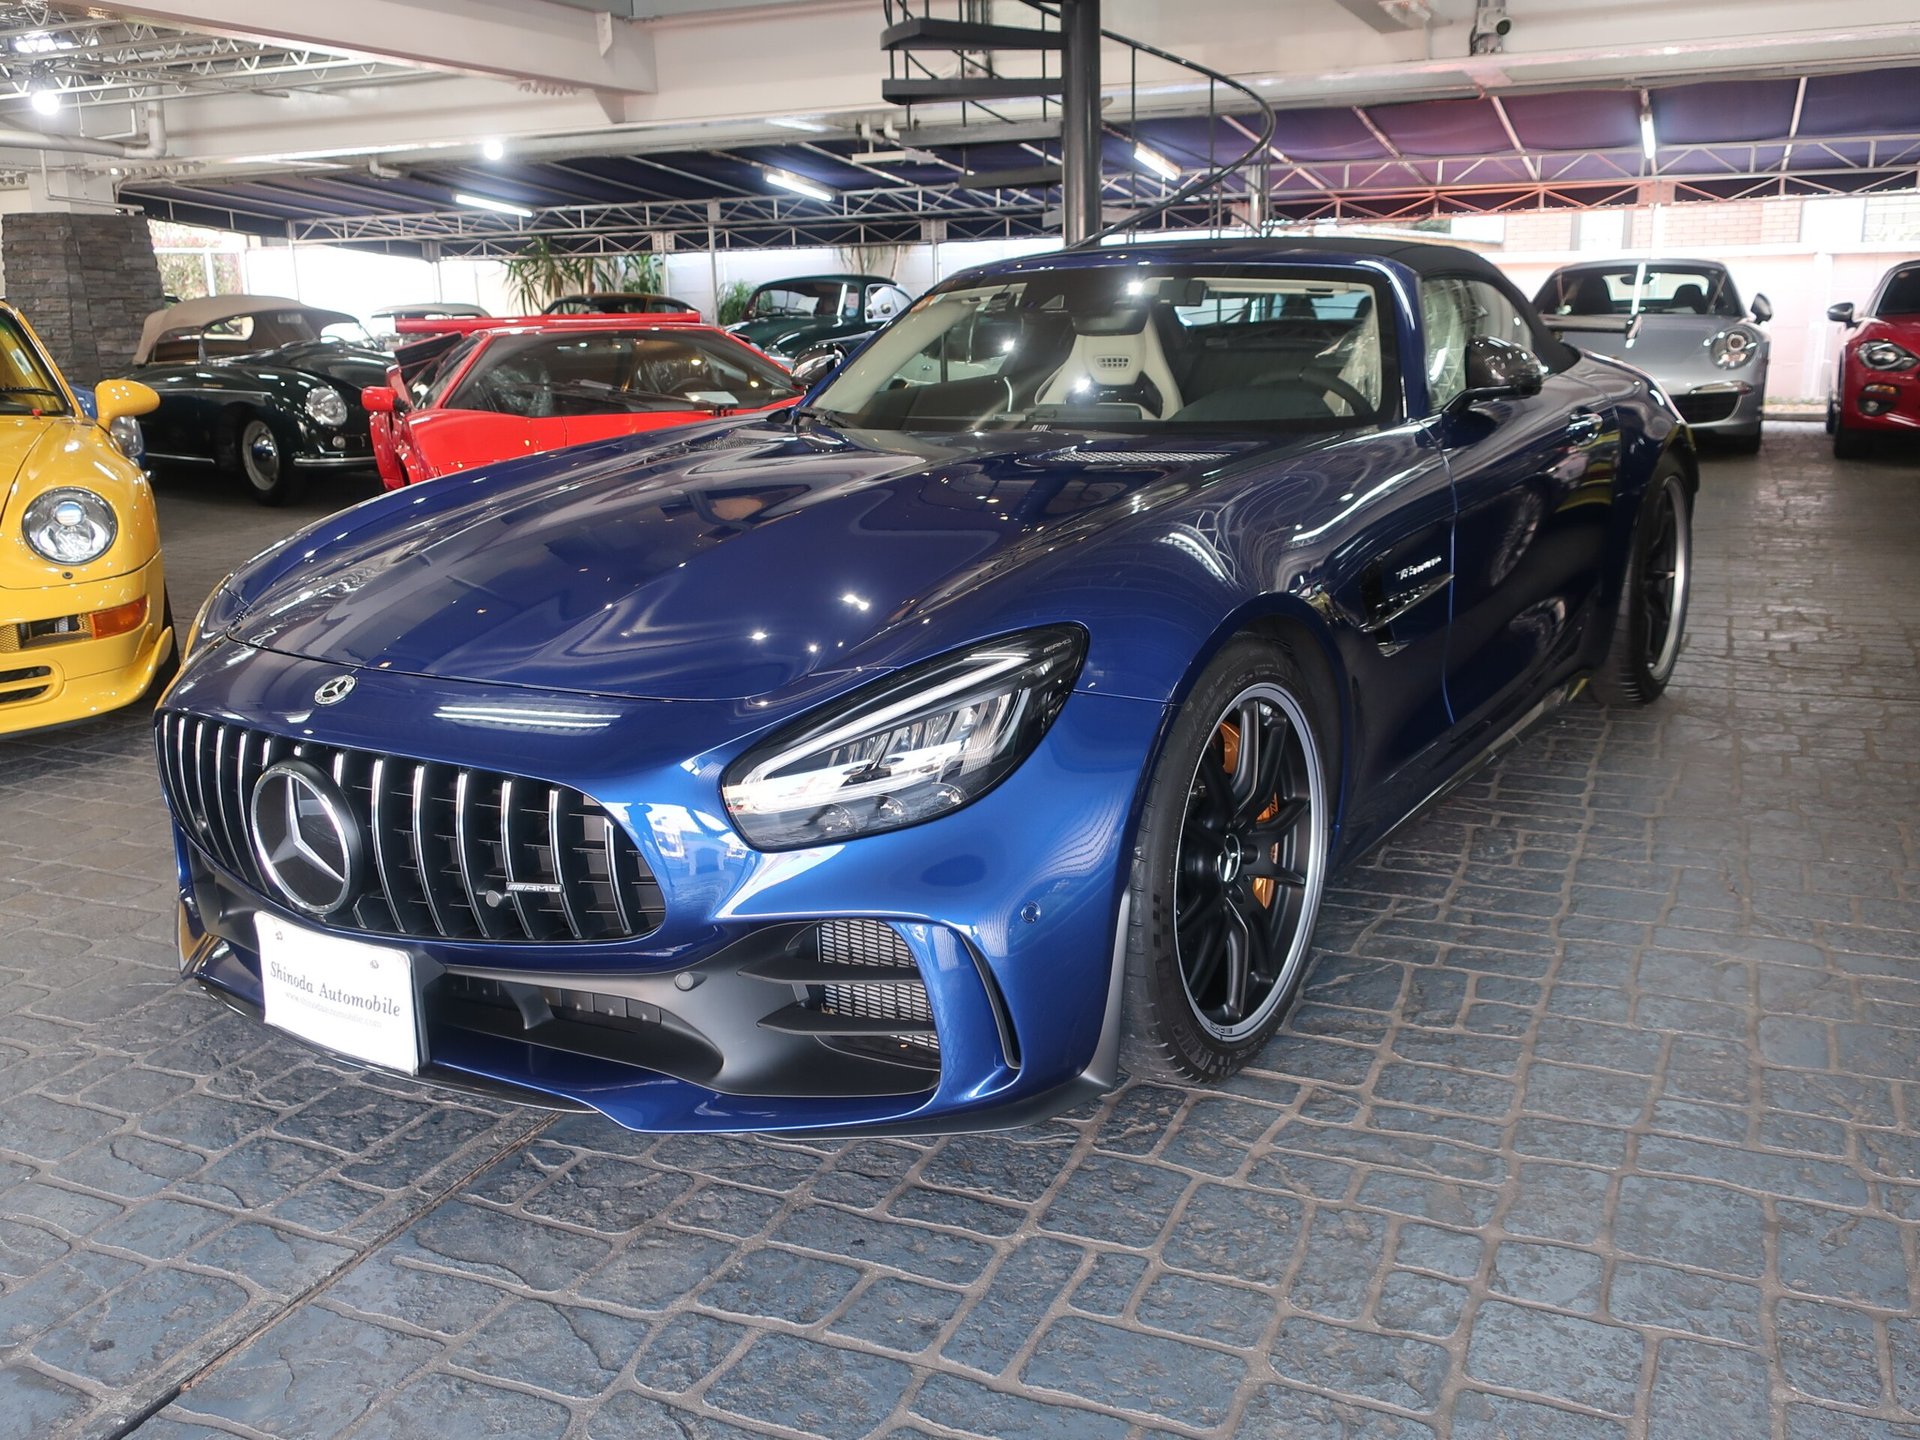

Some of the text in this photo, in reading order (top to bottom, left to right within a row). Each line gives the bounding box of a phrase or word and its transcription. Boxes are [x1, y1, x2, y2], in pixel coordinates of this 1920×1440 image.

[523, 883, 561, 893] AMG
[270, 961, 314, 993] Shinoda
[319, 983, 401, 1017] Automobile
